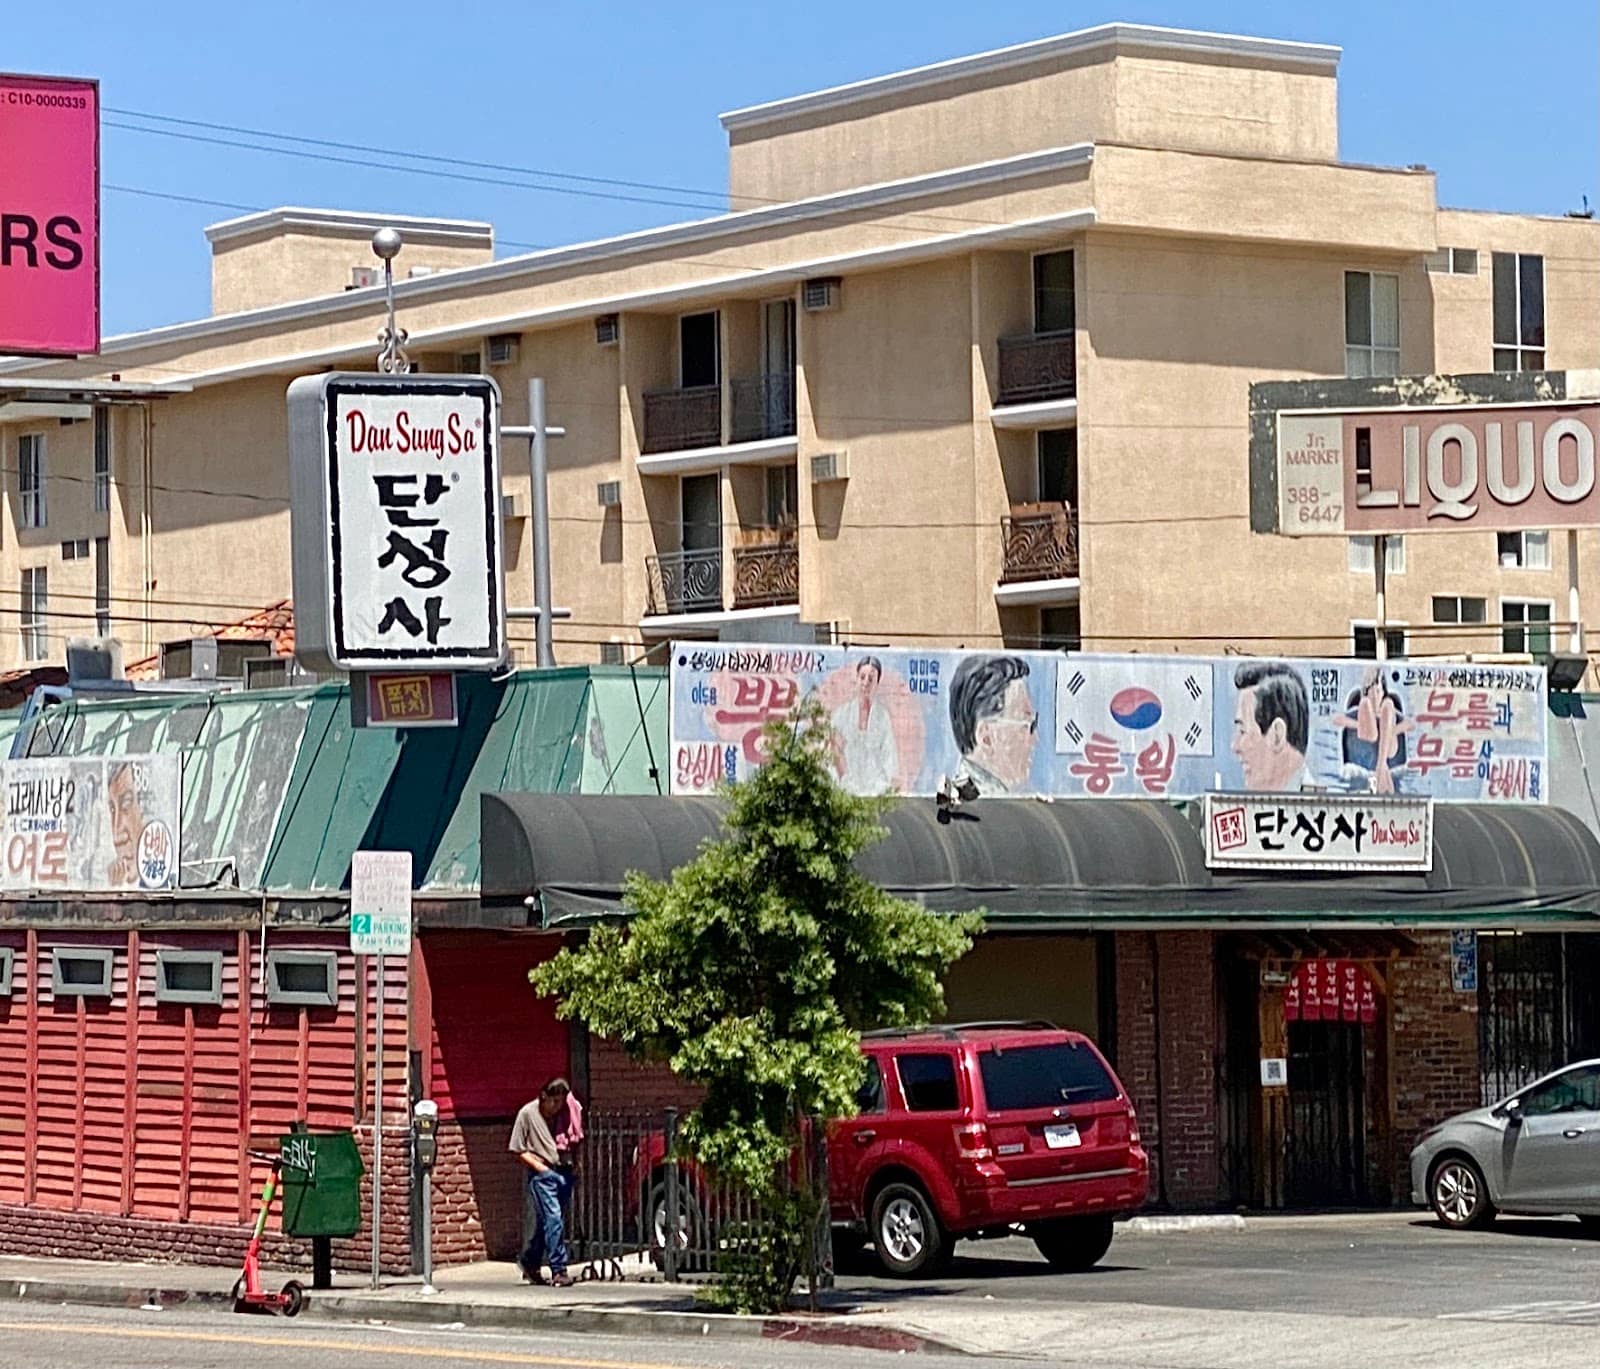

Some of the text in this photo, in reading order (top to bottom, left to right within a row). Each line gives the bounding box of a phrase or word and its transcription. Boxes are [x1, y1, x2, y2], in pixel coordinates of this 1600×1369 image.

[8, 91, 87, 110] C10-0000339
[1, 212, 83, 270] RS
[346, 410, 478, 460] Dan Sung Sa
[1286, 449, 1340, 465] MARKET
[1299, 505, 1342, 522] 6447
[373, 473, 452, 645] 단성사
[1312, 669, 1339, 686] 안성기
[1070, 732, 1175, 794] 통일
[1254, 808, 1367, 852] 단성사
[1371, 819, 1421, 848] Dan Sung Sa
[8, 831, 69, 882] 여로
[357, 916, 366, 932] 2
[373, 922, 408, 934] PARKING
